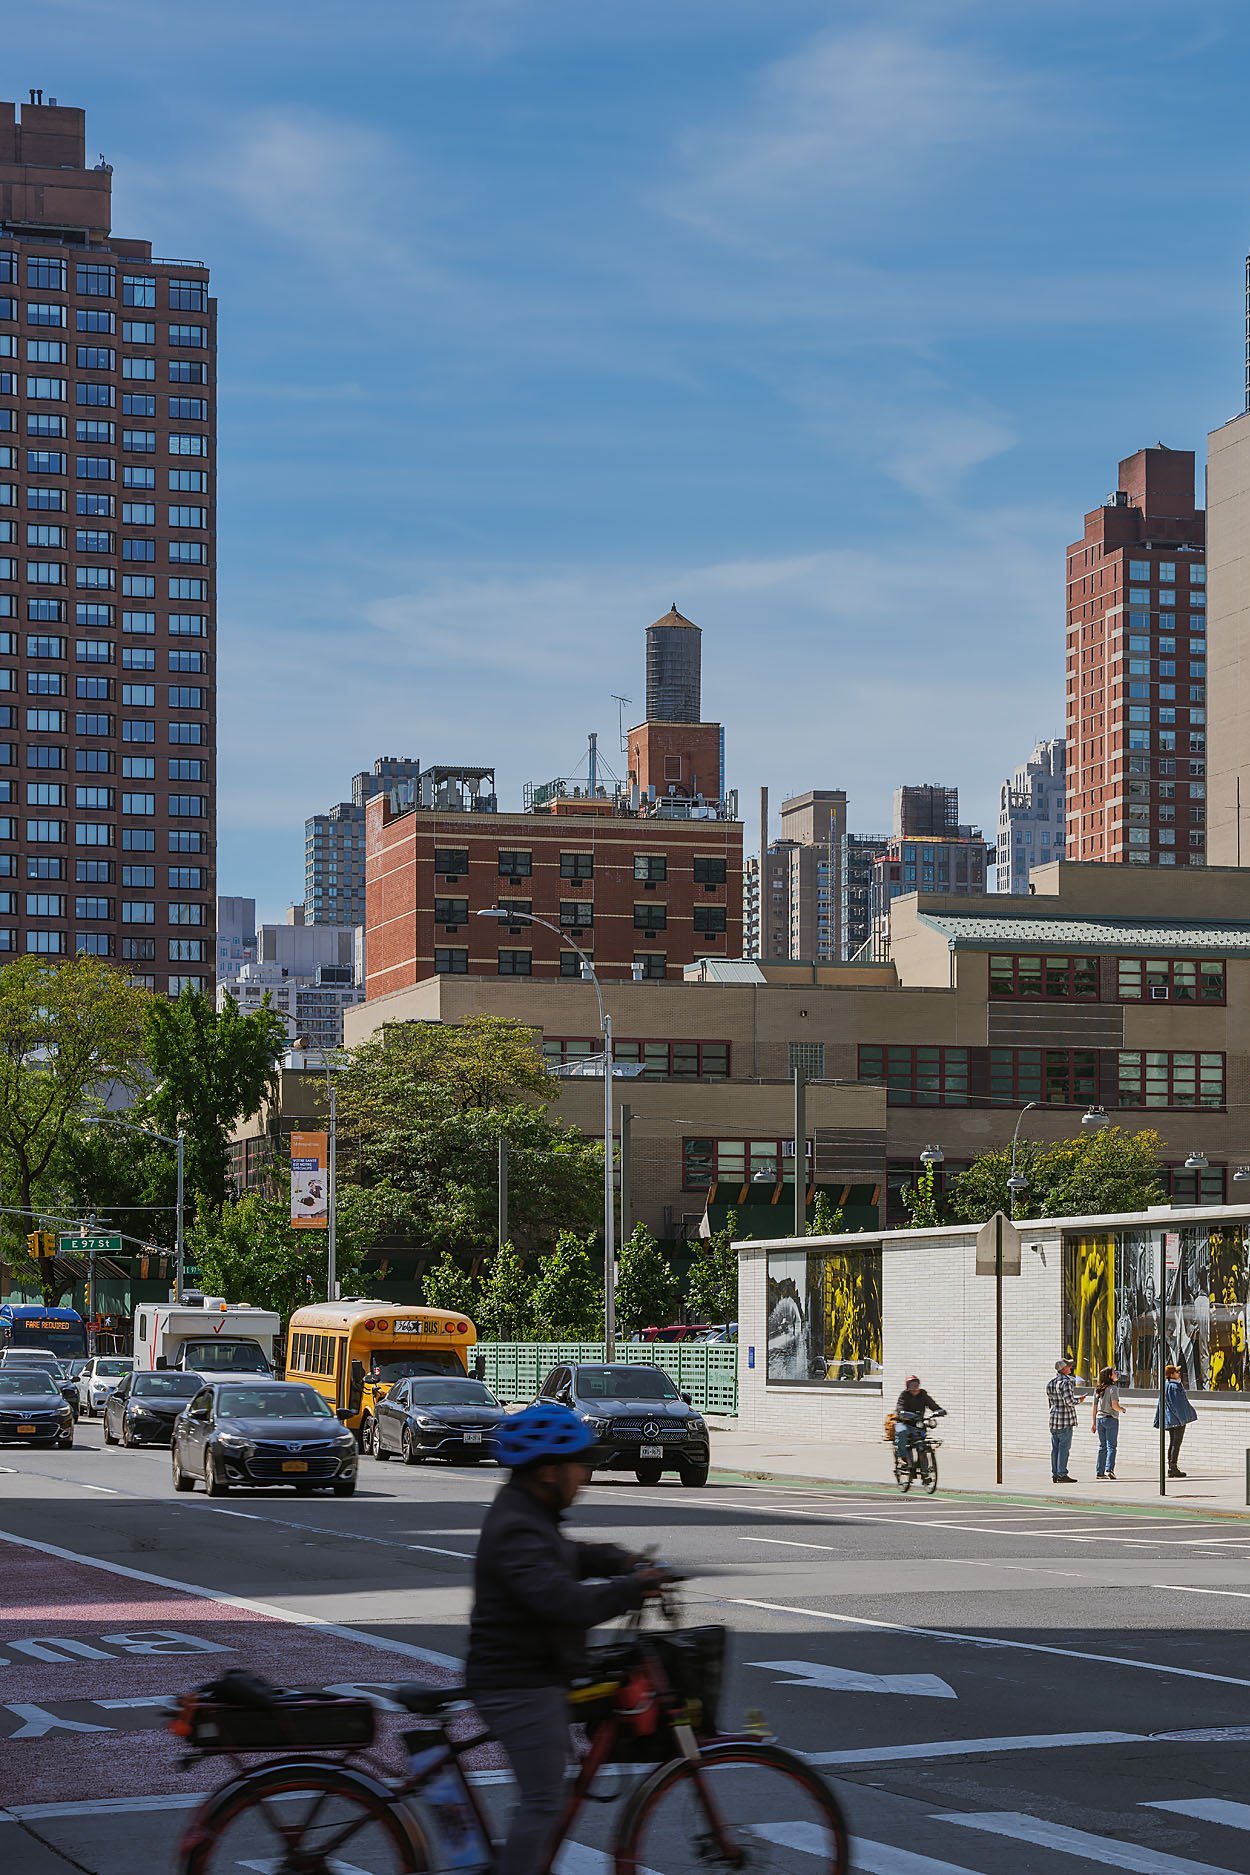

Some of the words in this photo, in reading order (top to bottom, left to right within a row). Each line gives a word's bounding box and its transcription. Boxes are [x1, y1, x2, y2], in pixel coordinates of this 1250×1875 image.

[71, 1240, 78, 1248] E
[81, 1240, 95, 1248] 97
[98, 1240, 110, 1248] St
[25, 1320, 41, 1329] FARE
[41, 1321, 70, 1330] REQUIRED
[423, 1321, 438, 1333] BUS
[0, 1630, 237, 1665] BU
